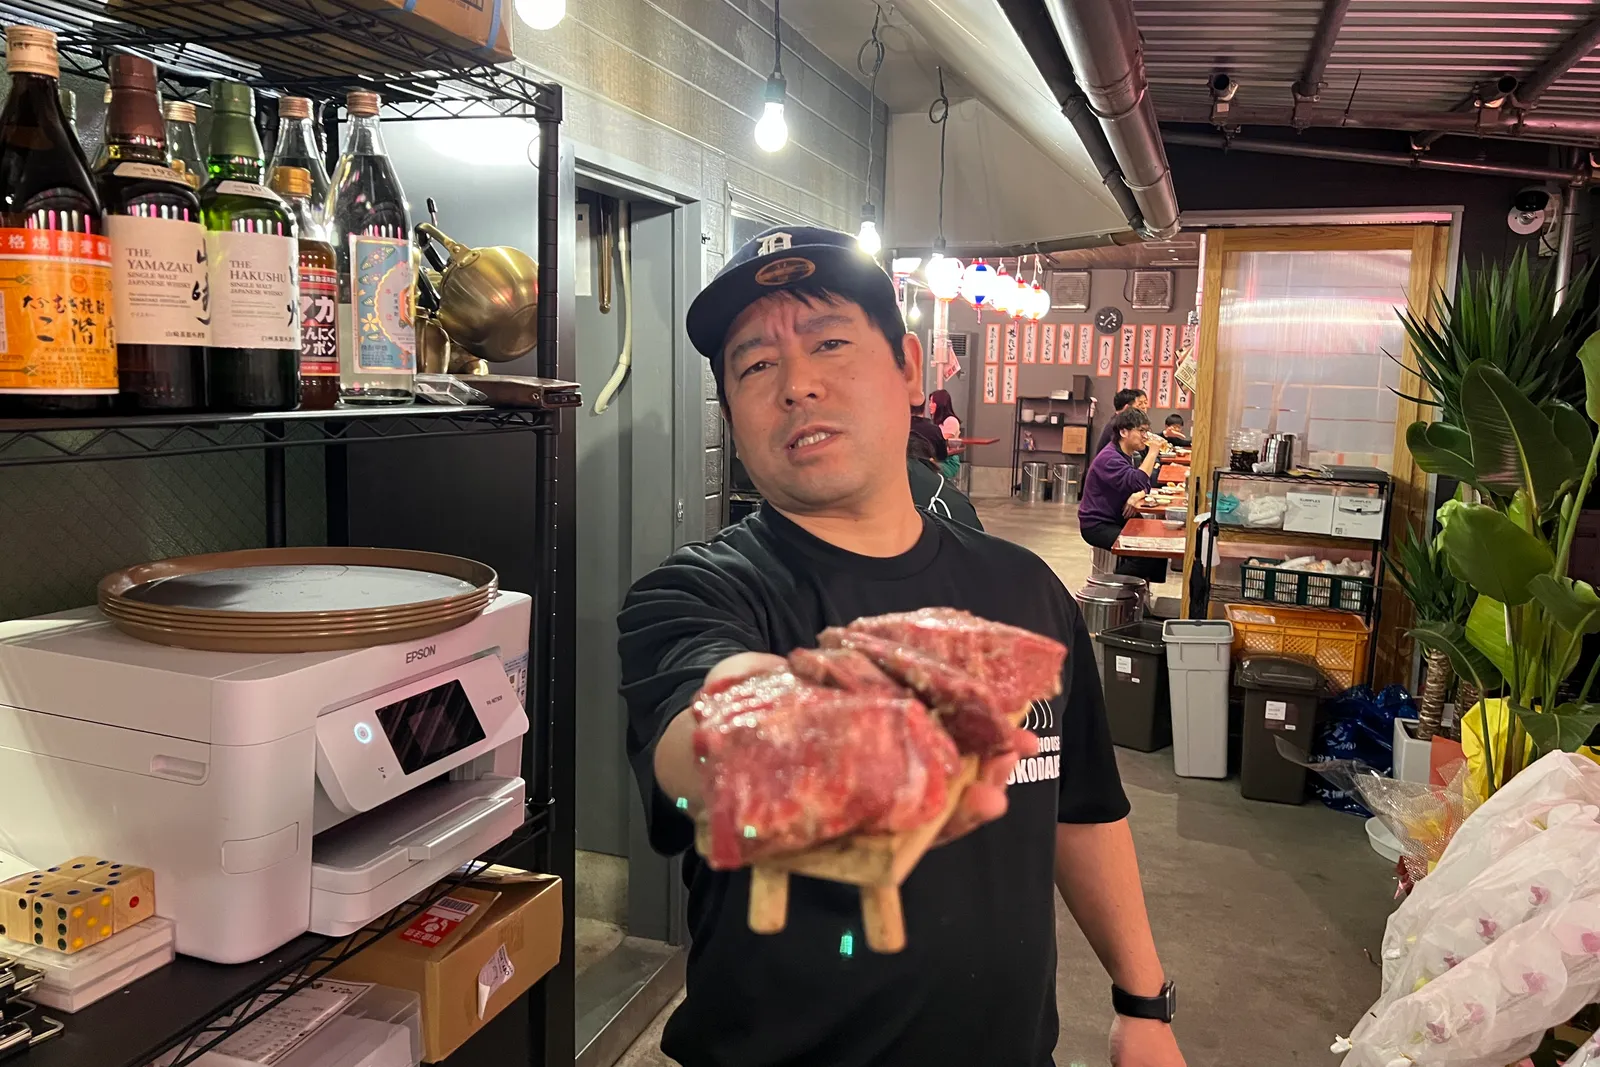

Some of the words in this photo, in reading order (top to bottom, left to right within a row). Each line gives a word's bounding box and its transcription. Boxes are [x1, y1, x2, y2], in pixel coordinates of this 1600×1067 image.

[0, 233, 112, 257] 格焼酎麦製
[125, 247, 152, 258] THE
[127, 259, 194, 274] YAMAZAKI
[229, 260, 252, 269] THE
[127, 271, 156, 279] SINGLE
[157, 273, 178, 281] MALT
[230, 269, 287, 284] HAKUSHU
[127, 279, 166, 287] JAPANESE
[167, 281, 191, 289] WHISKY
[405, 644, 436, 664] EPSON
